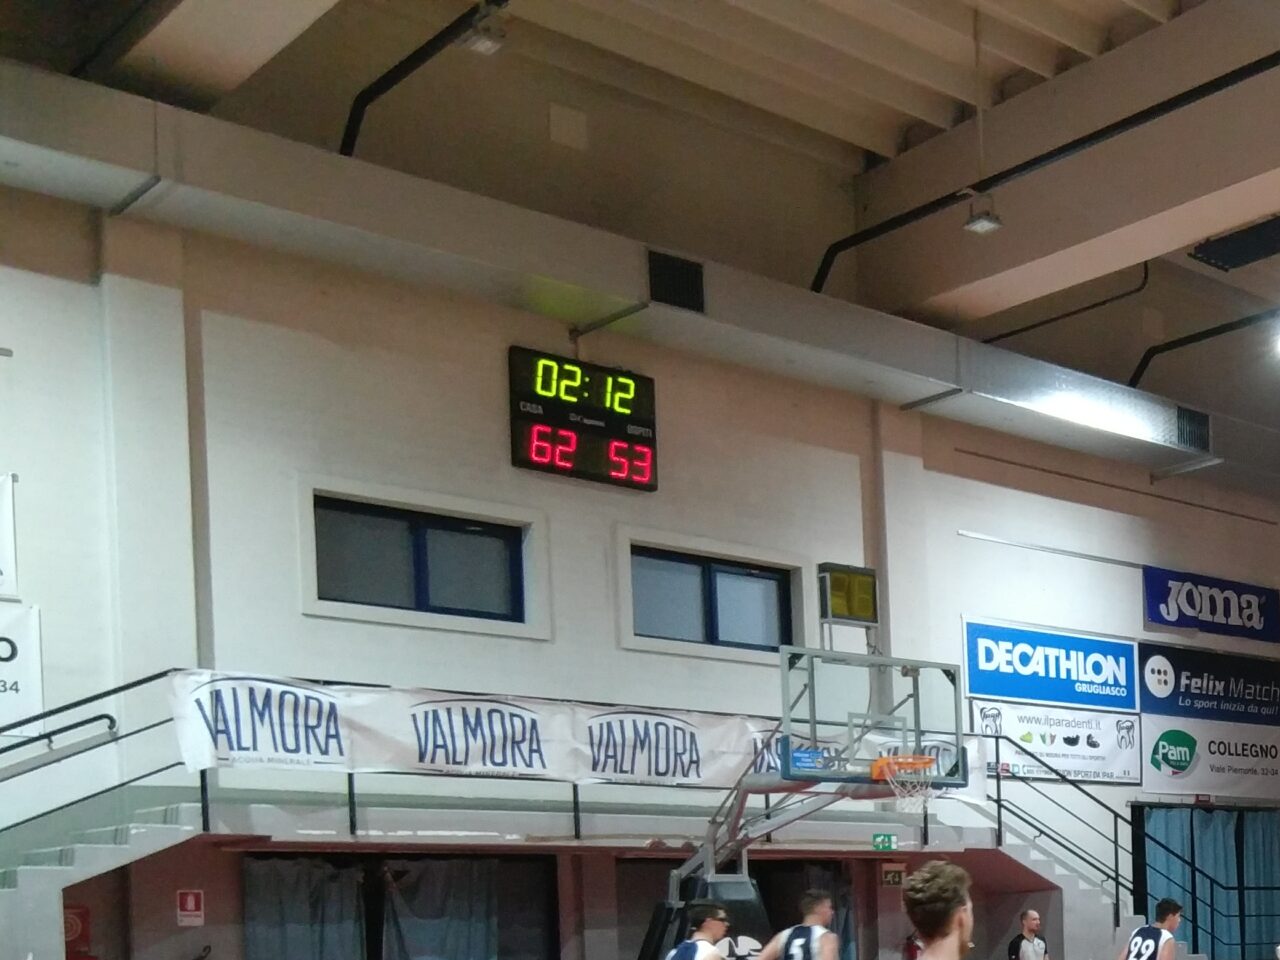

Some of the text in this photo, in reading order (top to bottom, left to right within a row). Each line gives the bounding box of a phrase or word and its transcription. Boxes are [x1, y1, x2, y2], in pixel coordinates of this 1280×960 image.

[536, 359, 635, 414] 02:12
[531, 424, 577, 468] 62
[609, 440, 653, 484] 53
[977, 637, 1127, 686] DECATHLON
[1075, 682, 1127, 697] GRUGLIASCO
[1180, 671, 1280, 702] Felix Match
[194, 686, 344, 757] VALMORA
[1017, 714, 1101, 731] www.ilparadenti.it
[1178, 696, 1279, 716] Lo sport inizia da qui!
[411, 706, 547, 769] VALMORA
[588, 719, 702, 778] VALMORA
[1158, 740, 1190, 762] Pam
[1208, 740, 1278, 759] COLLEGNO
[1209, 764, 1226, 774] Viale
